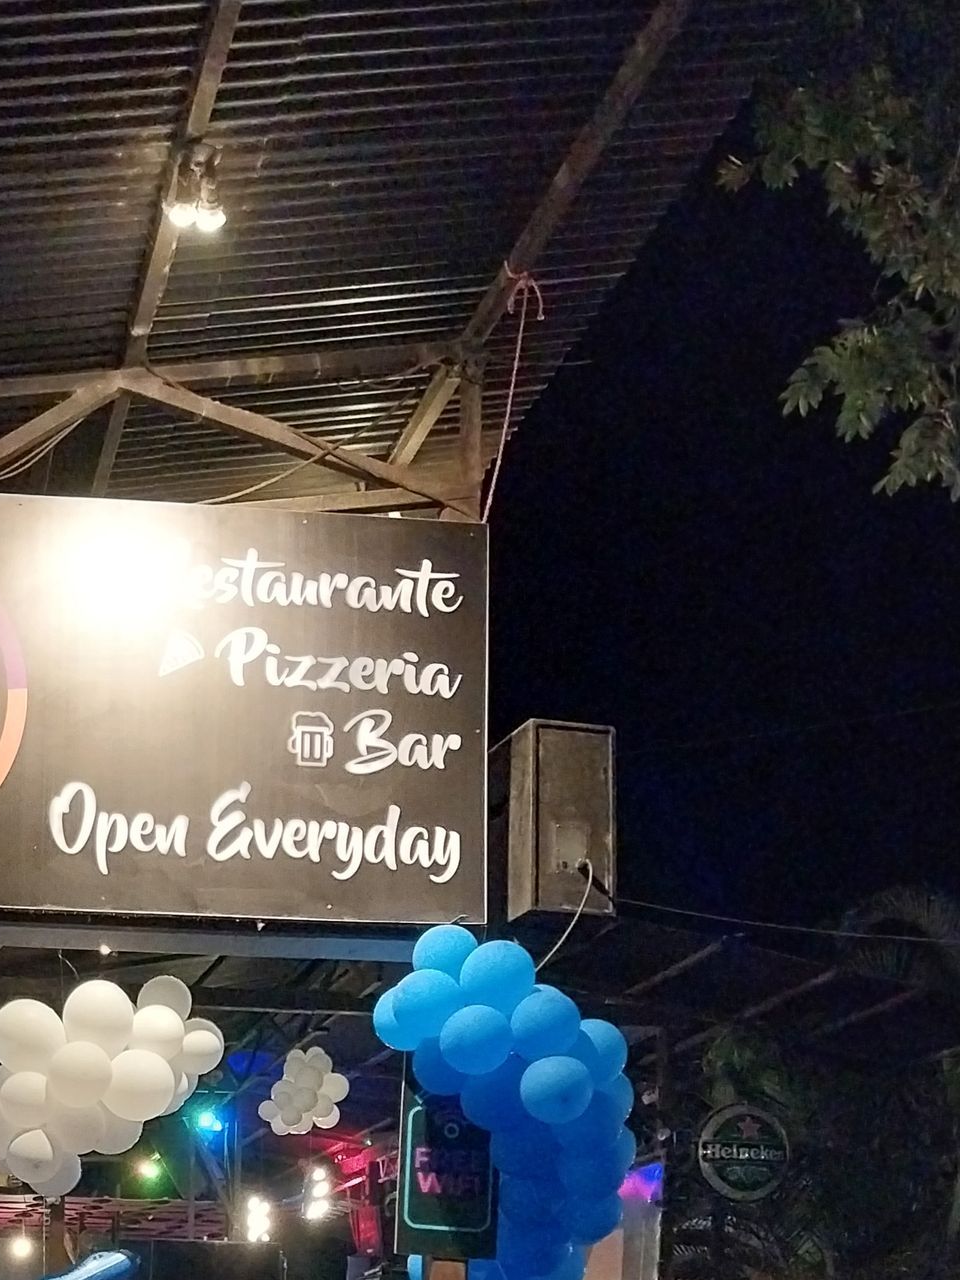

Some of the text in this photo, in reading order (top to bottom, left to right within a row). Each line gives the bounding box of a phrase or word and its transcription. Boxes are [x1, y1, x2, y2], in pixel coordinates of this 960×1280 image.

[188, 547, 464, 618] estaurante
[214, 626, 463, 699] Pizzeria
[343, 708, 462, 774] Bar
[48, 780, 461, 884] Open Everyday
[706, 1143, 784, 1160] Heineken
